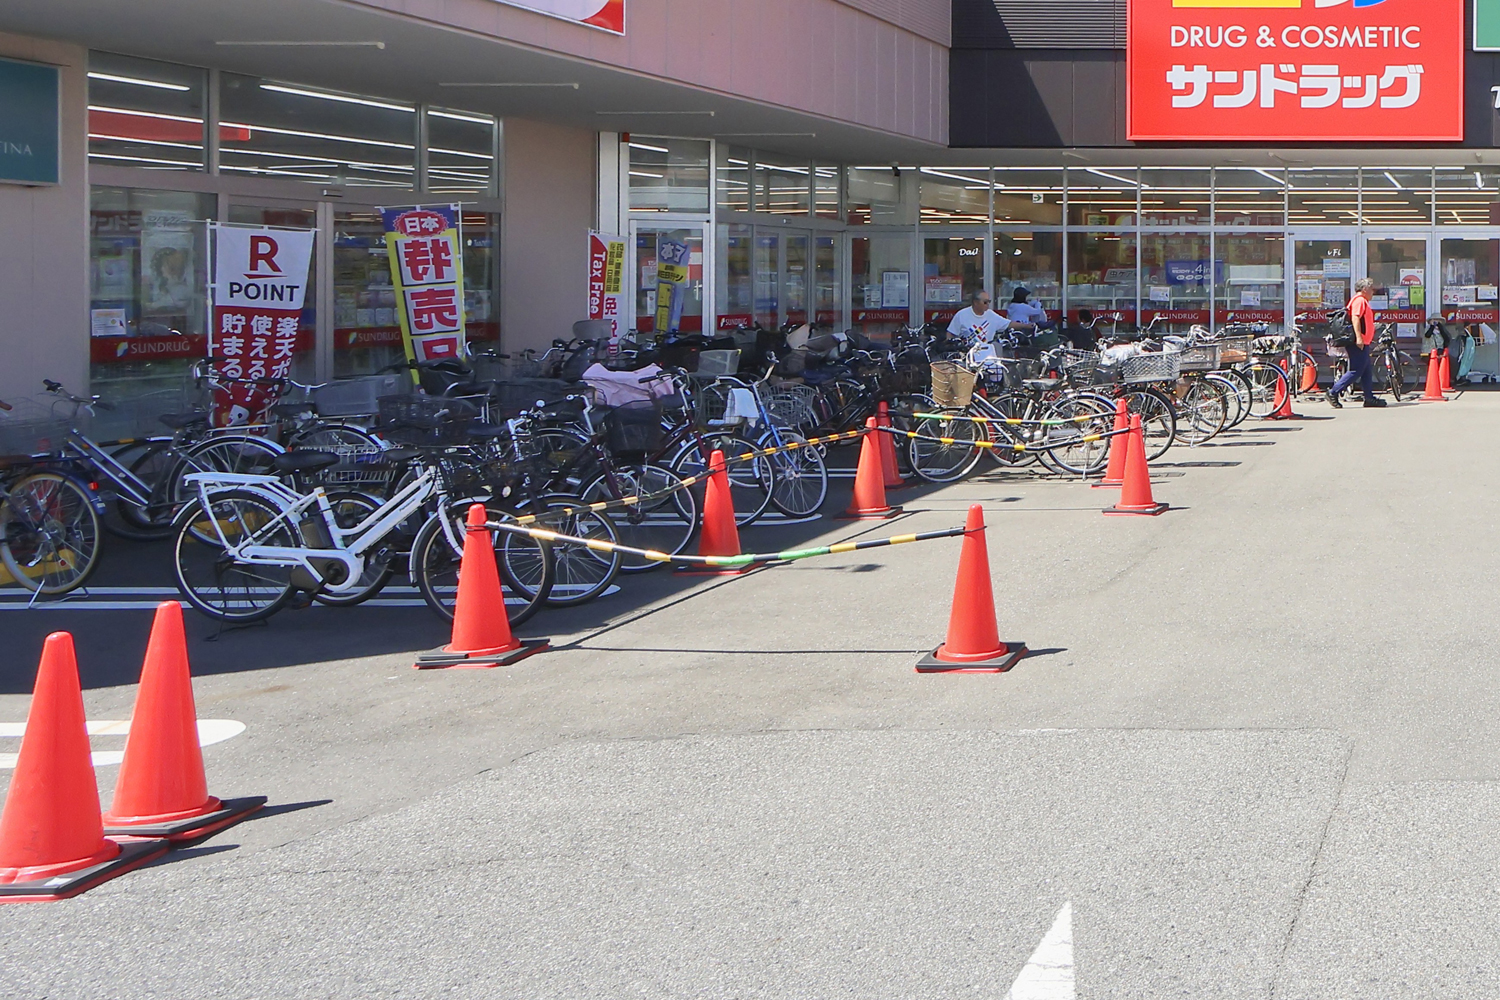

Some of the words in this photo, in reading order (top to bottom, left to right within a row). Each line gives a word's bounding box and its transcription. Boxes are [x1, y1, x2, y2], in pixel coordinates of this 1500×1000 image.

[1171, 26, 1247, 48] DRUG
[1255, 26, 1277, 48] &
[1281, 26, 1421, 48] COSMETIC
[1166, 63, 1425, 109] サンドラッグ
[249, 235, 283, 273] R
[592, 251, 606, 277] Tax
[229, 282, 300, 302] POINT
[590, 281, 604, 314] Free
[867, 312, 904, 320] SUNDRUG
[1235, 312, 1273, 320] SUNDRUG
[131, 340, 191, 355] SUNDRUG
[358, 331, 400, 343] SUNDRUG
